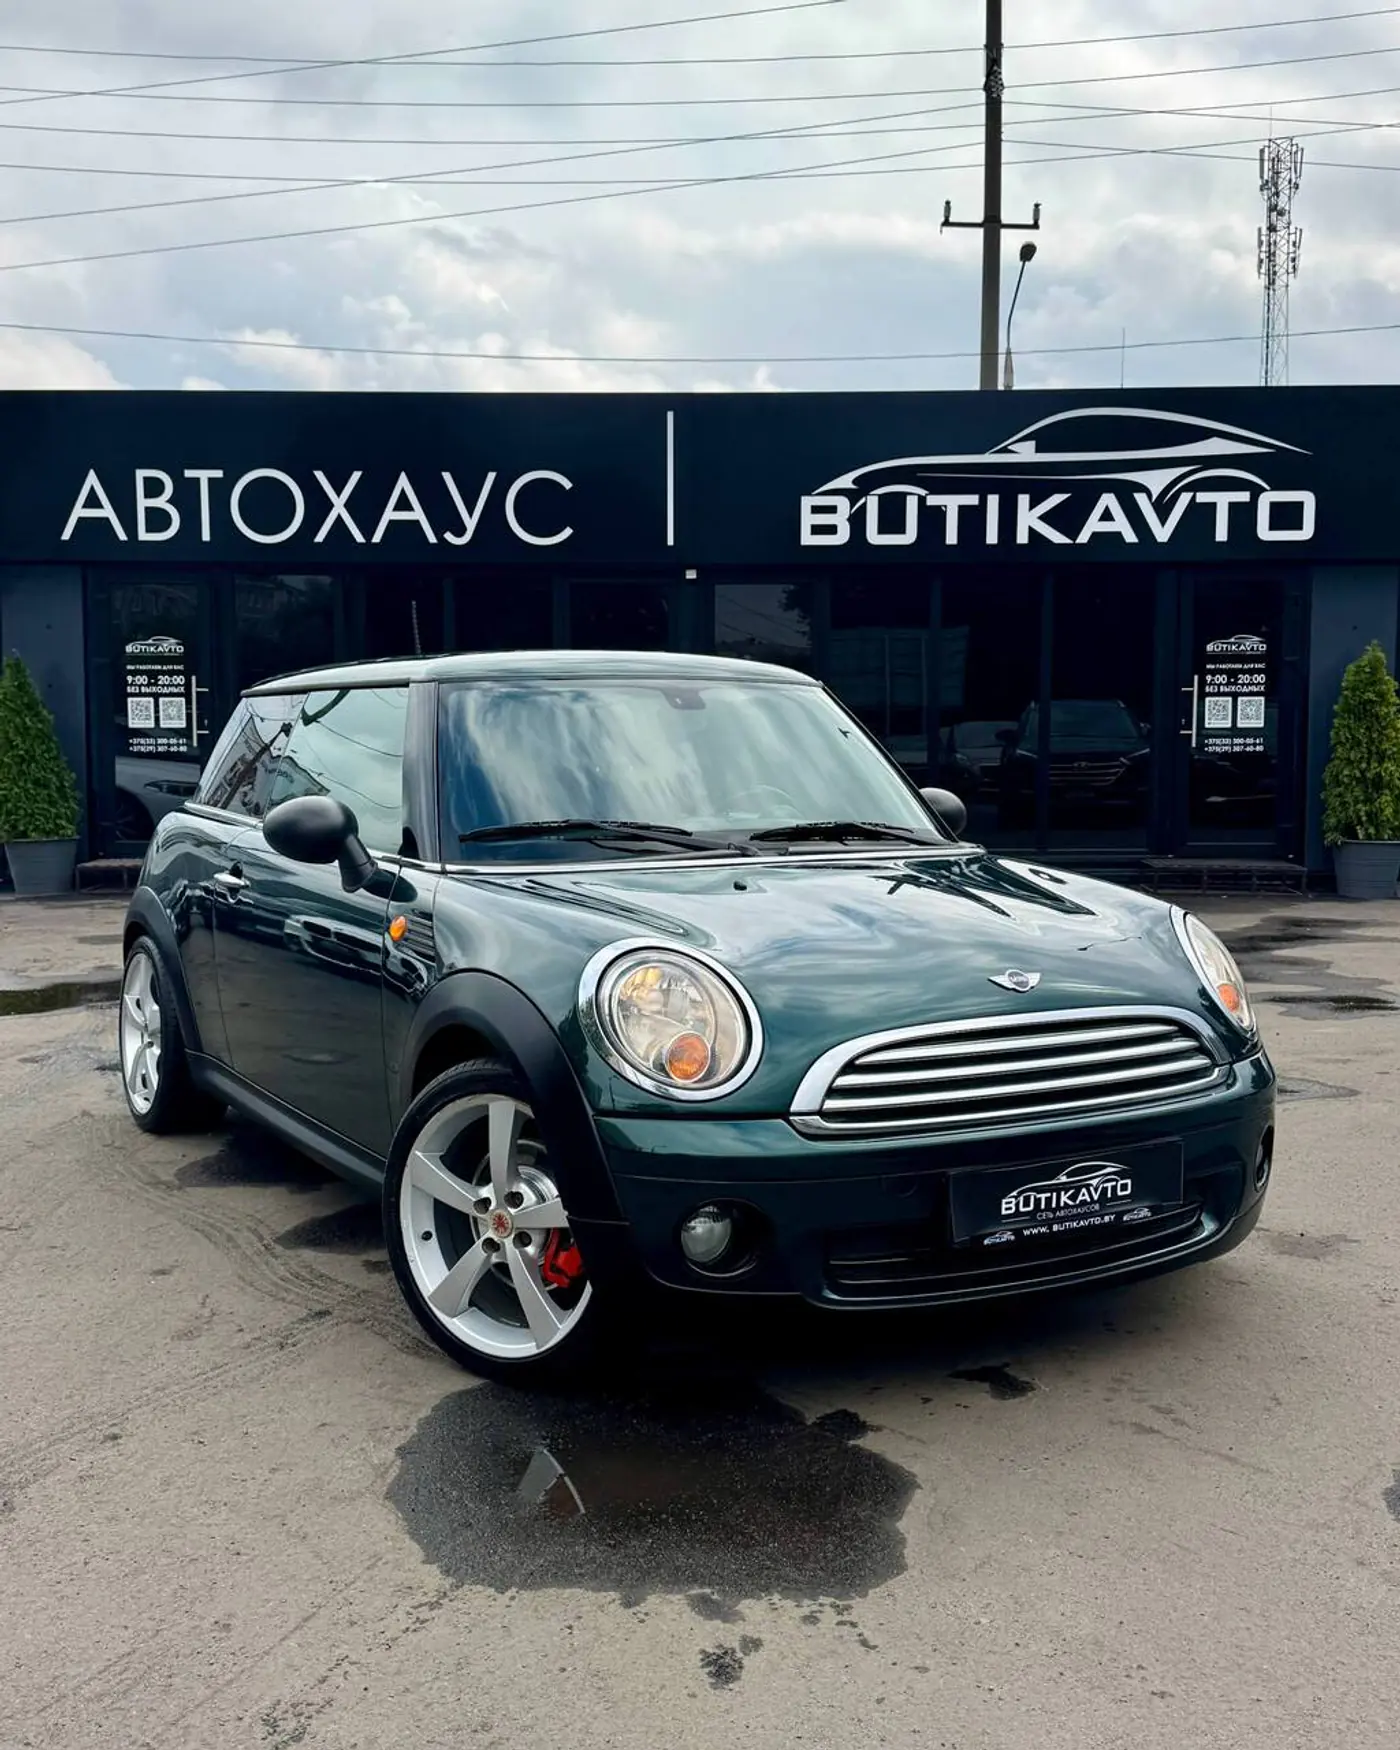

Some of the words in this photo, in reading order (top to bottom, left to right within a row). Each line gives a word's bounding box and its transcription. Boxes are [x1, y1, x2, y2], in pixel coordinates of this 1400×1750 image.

[60, 468, 574, 545] АВТОХАУС
[800, 489, 1317, 546] BUTIKAVTO
[125, 644, 185, 653] BUTIKAVTO
[1206, 643, 1267, 652] BUTIKAVTO
[126, 675, 148, 685] 9:00
[157, 675, 186, 685] 20:00
[1205, 674, 1228, 684] 9:00
[1237, 674, 1266, 684] 20:00
[1001, 1179, 1132, 1215] BUTIKAVTO
[1022, 1226, 1050, 1236] WWW.
[1052, 1214, 1116, 1232] BUTIKAVTO.BY
